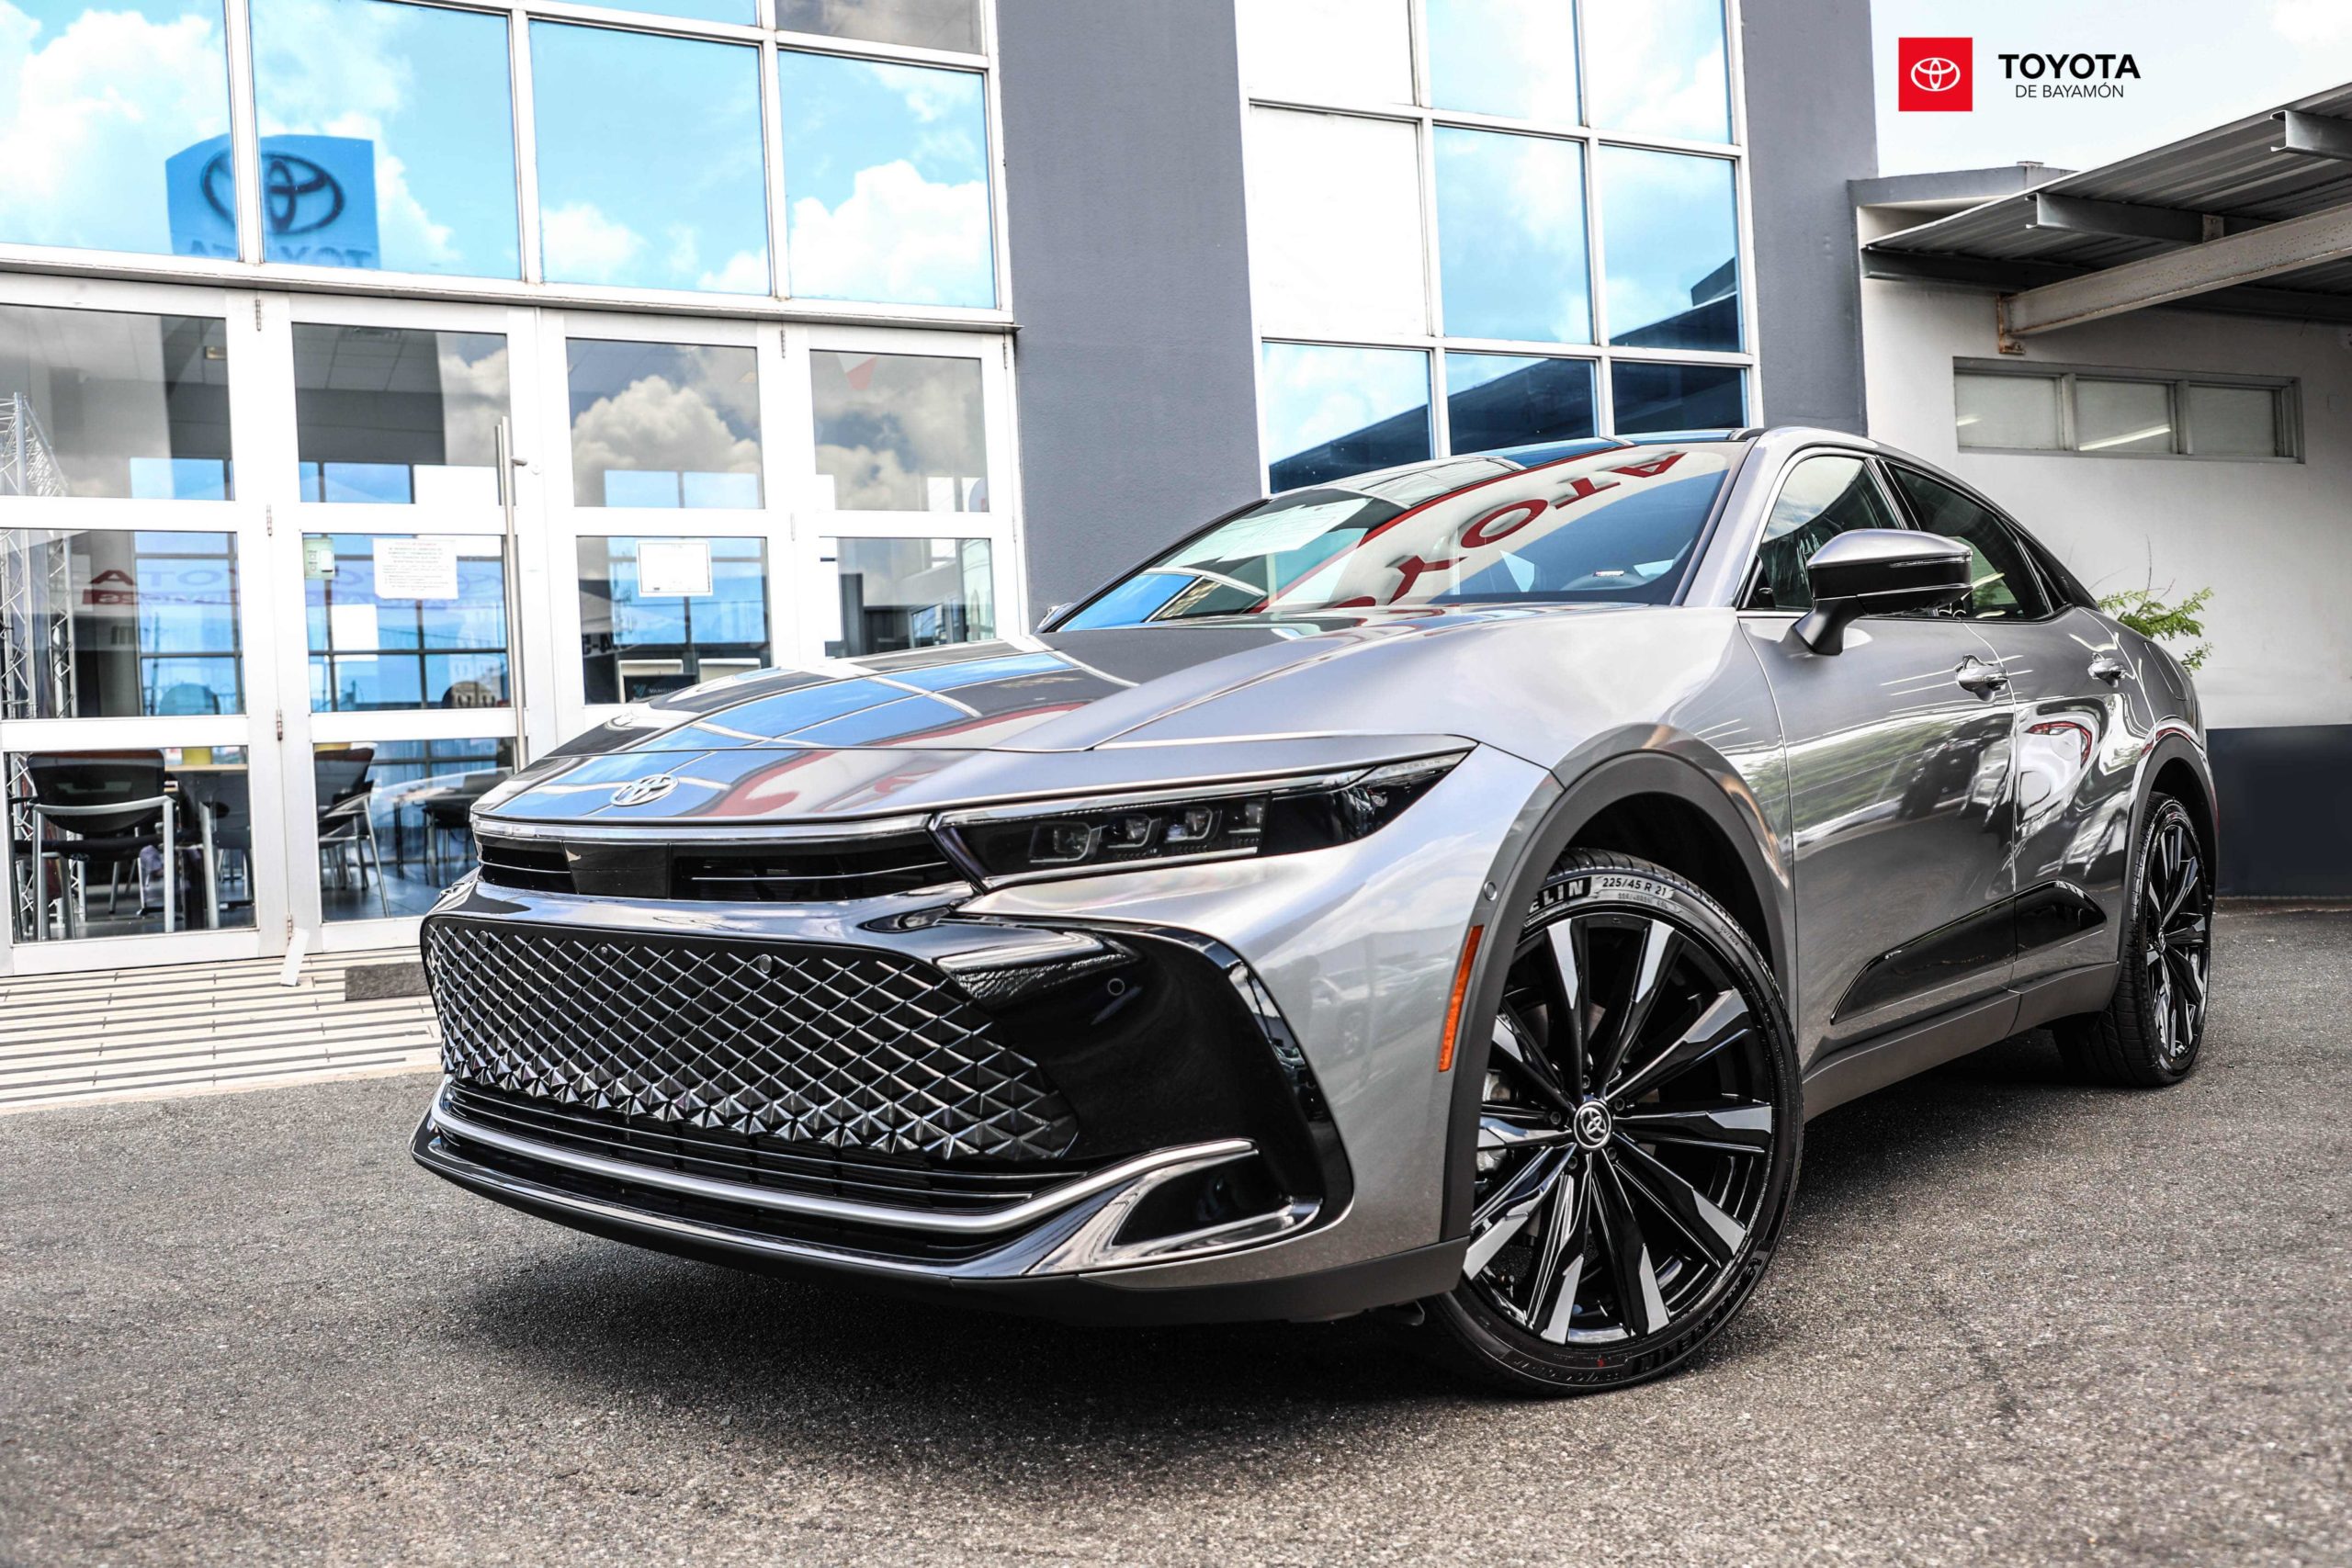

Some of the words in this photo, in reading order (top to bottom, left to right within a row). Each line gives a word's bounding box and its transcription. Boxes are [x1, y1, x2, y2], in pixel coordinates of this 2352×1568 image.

[1602, 877, 1642, 890] 225/45
[1644, 882, 1652, 892] R
[1655, 885, 1668, 897] 21
